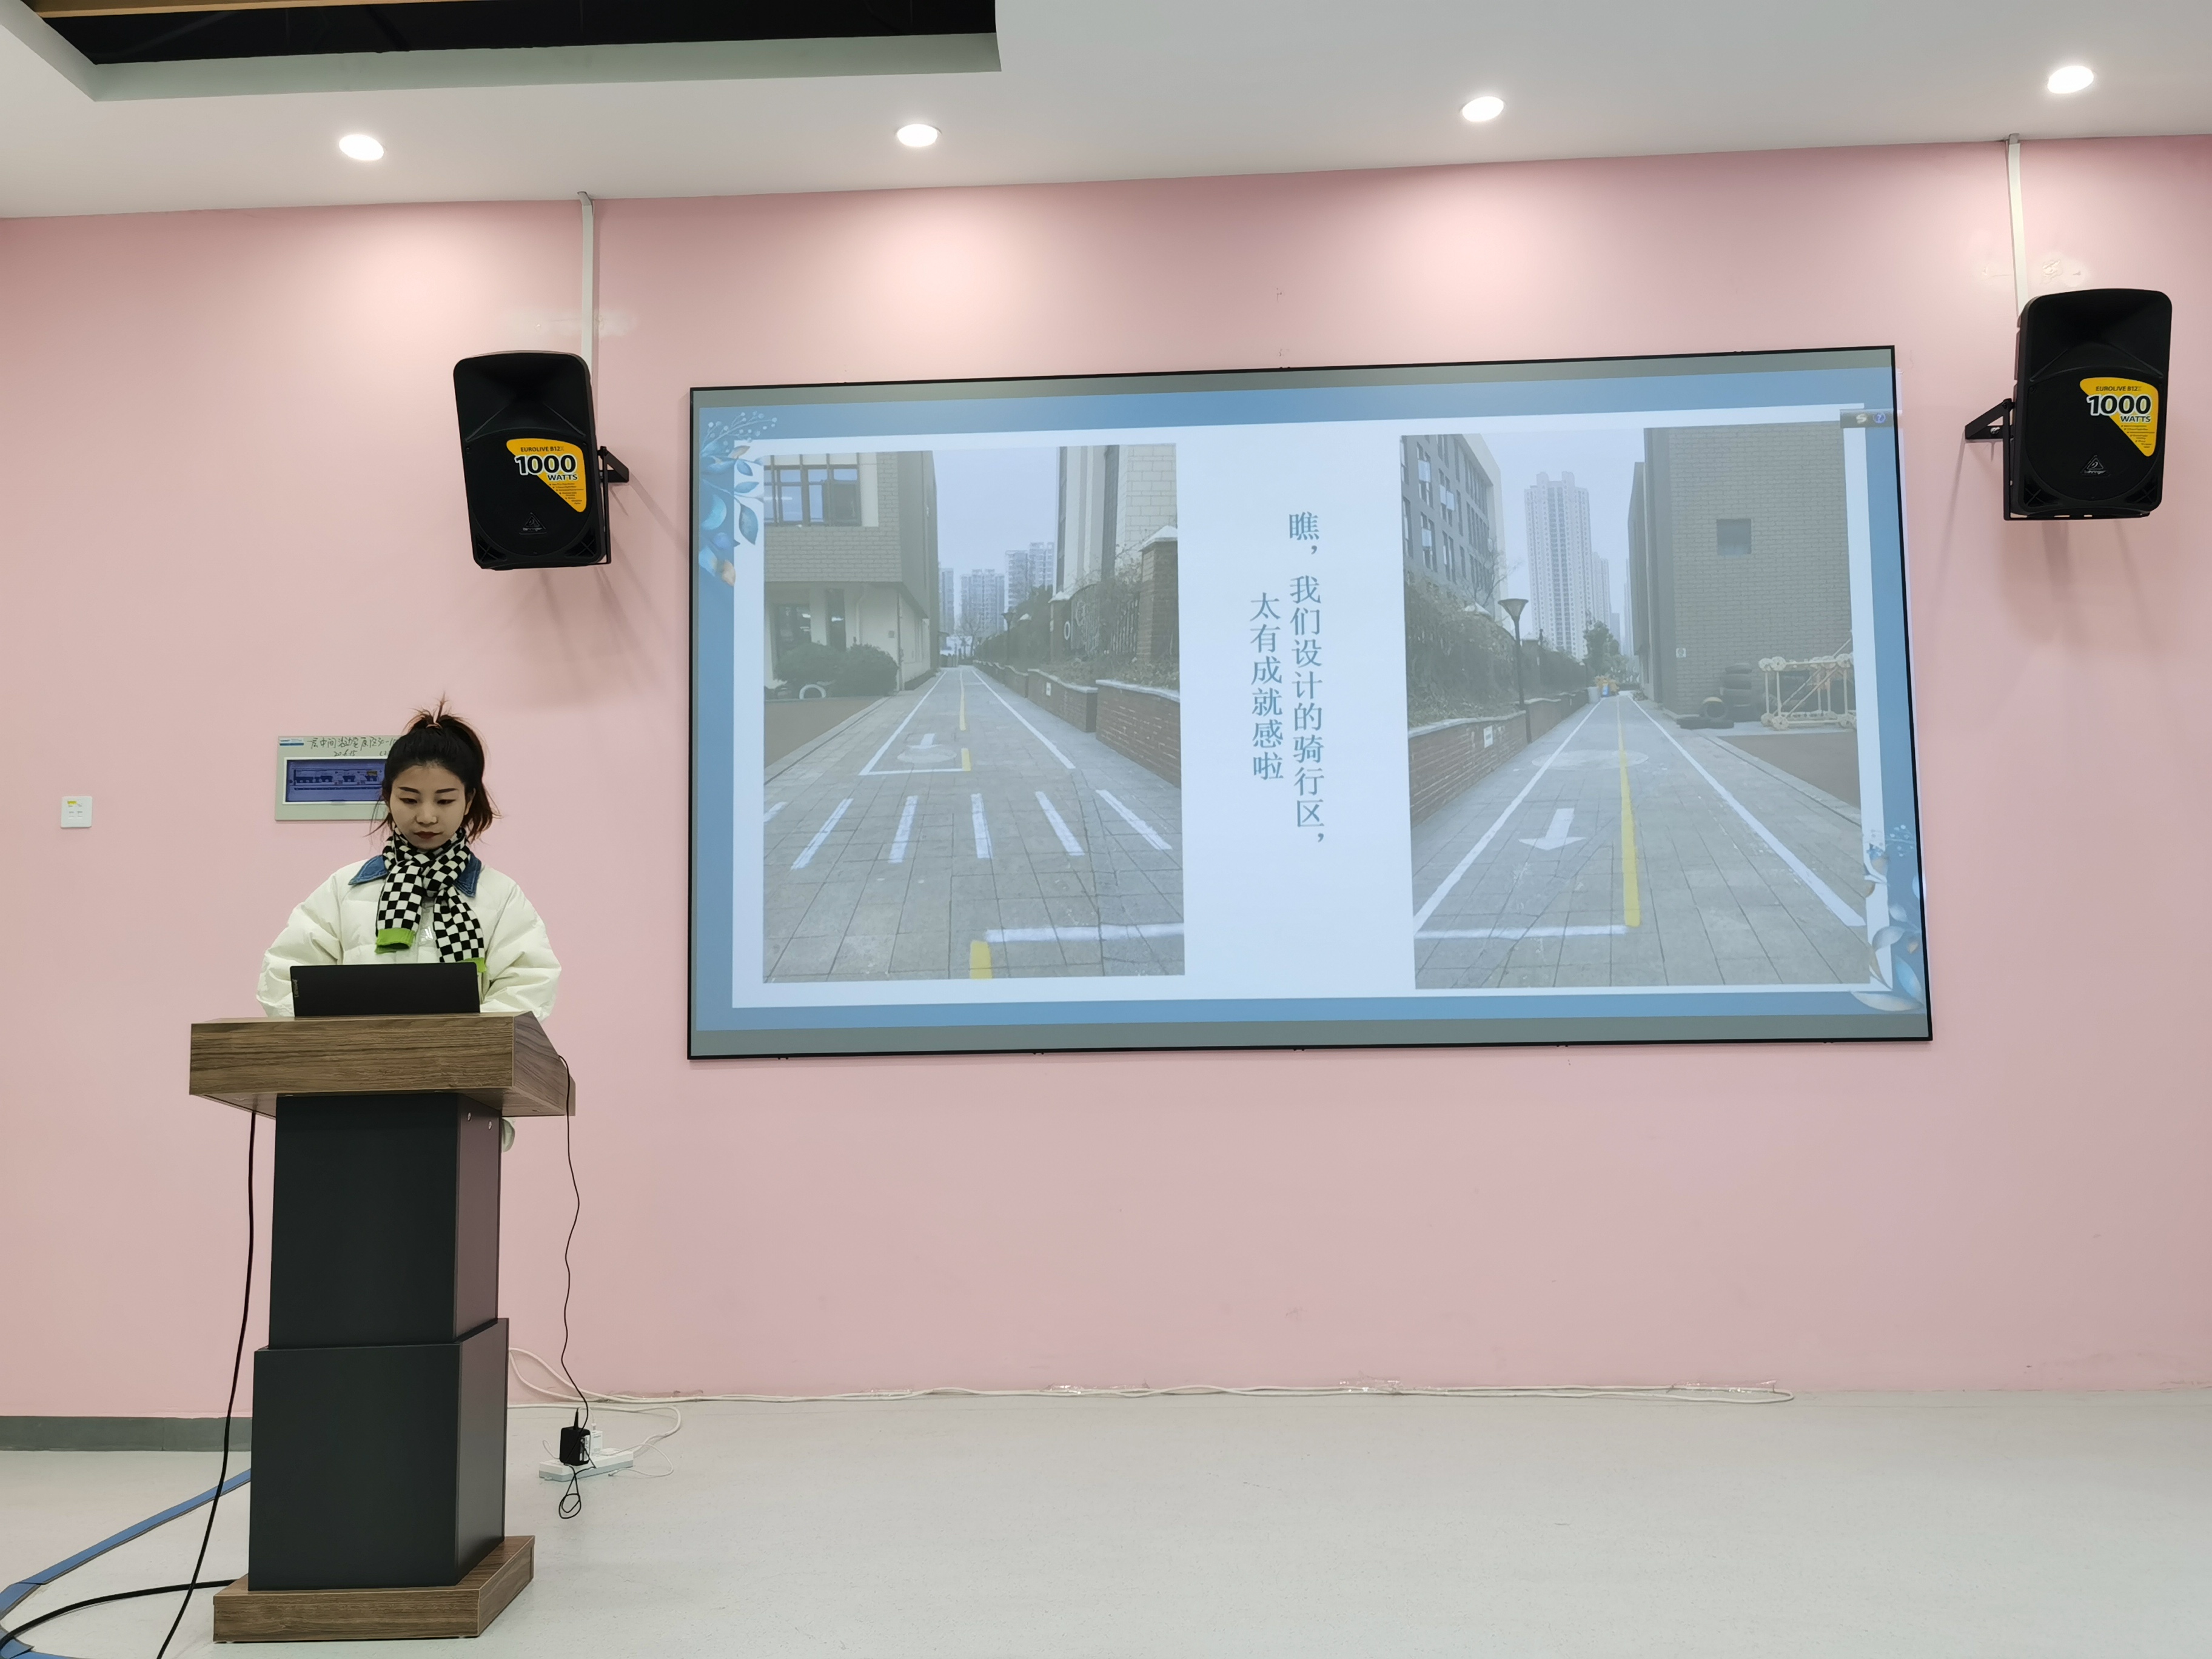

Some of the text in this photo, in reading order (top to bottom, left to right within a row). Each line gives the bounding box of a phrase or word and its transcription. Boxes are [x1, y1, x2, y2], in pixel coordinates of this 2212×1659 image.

[2086, 394, 2151, 415] 1000
[514, 454, 577, 475] 1000
[1250, 592, 1284, 781] 太有成就感啦
